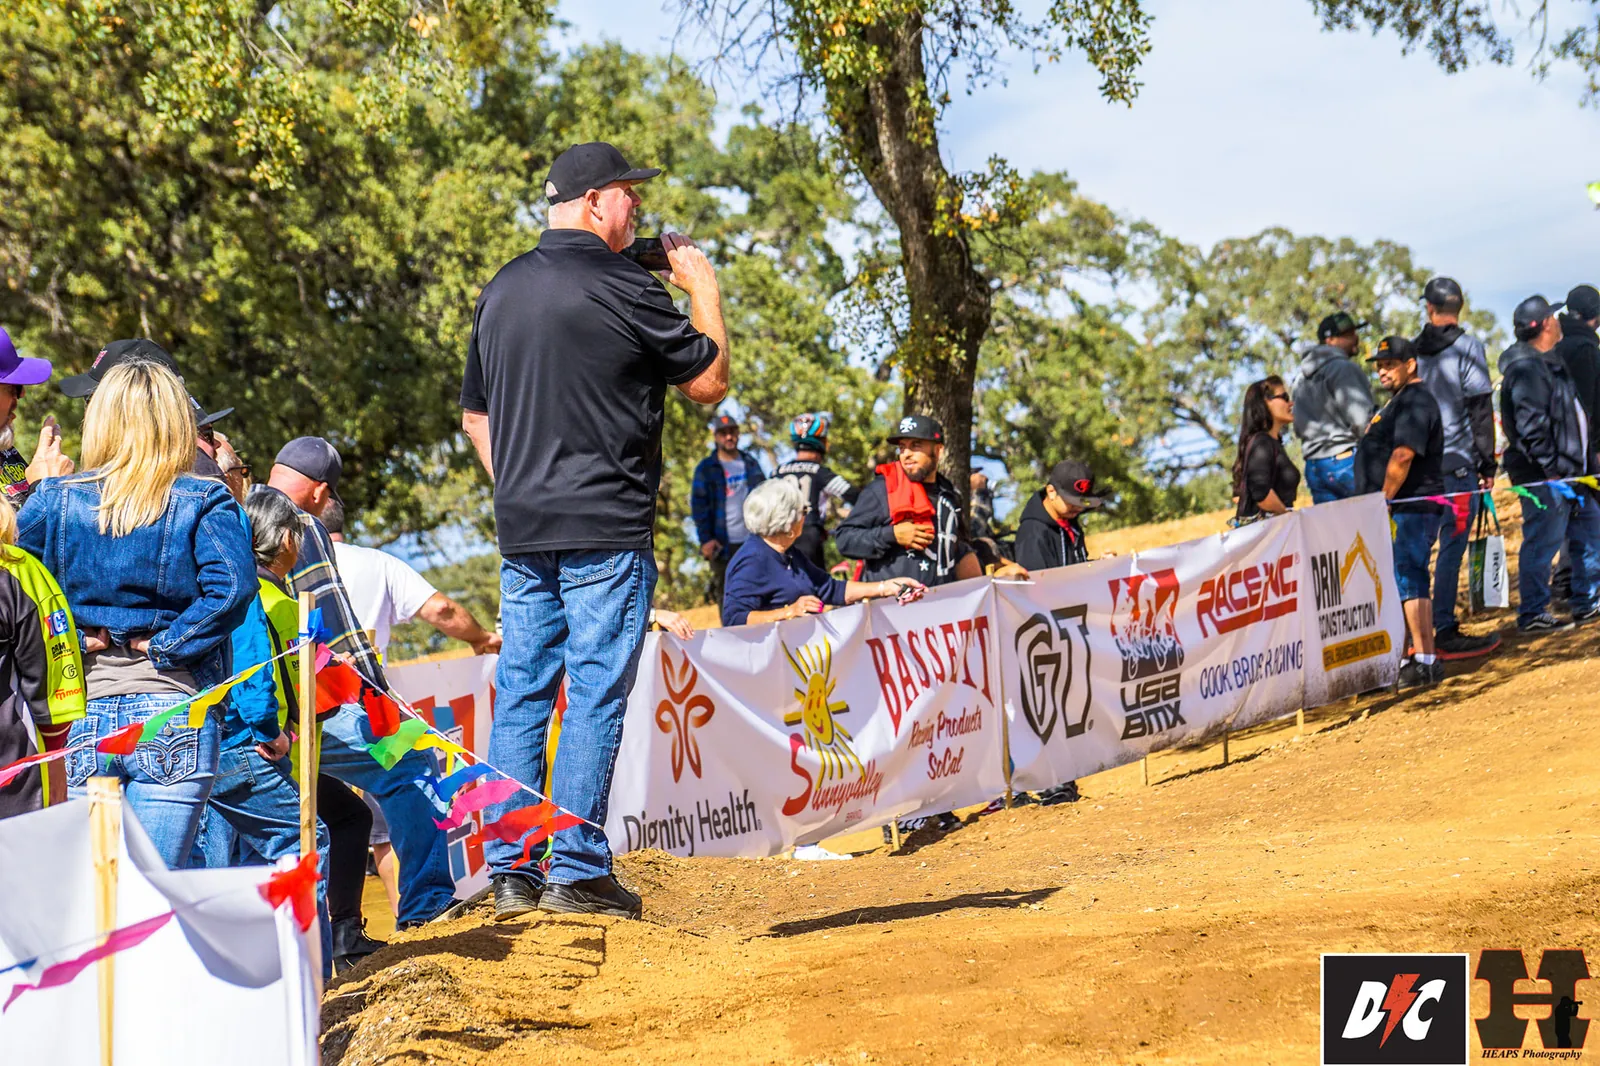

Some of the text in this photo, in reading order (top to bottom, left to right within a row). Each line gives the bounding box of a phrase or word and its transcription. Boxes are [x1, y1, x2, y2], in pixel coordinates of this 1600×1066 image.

[1311, 550, 1341, 611] DRM
[865, 615, 995, 738] BASSETT
[1015, 603, 1092, 746] GT
[1199, 663, 1233, 700] COOK
[1264, 640, 1304, 679] RACING
[937, 704, 982, 740] Products
[1120, 700, 1187, 741] BMX
[781, 732, 885, 817] Sunnyvalley
[927, 747, 965, 781] SoCal
[622, 788, 758, 857] Dignity Health
